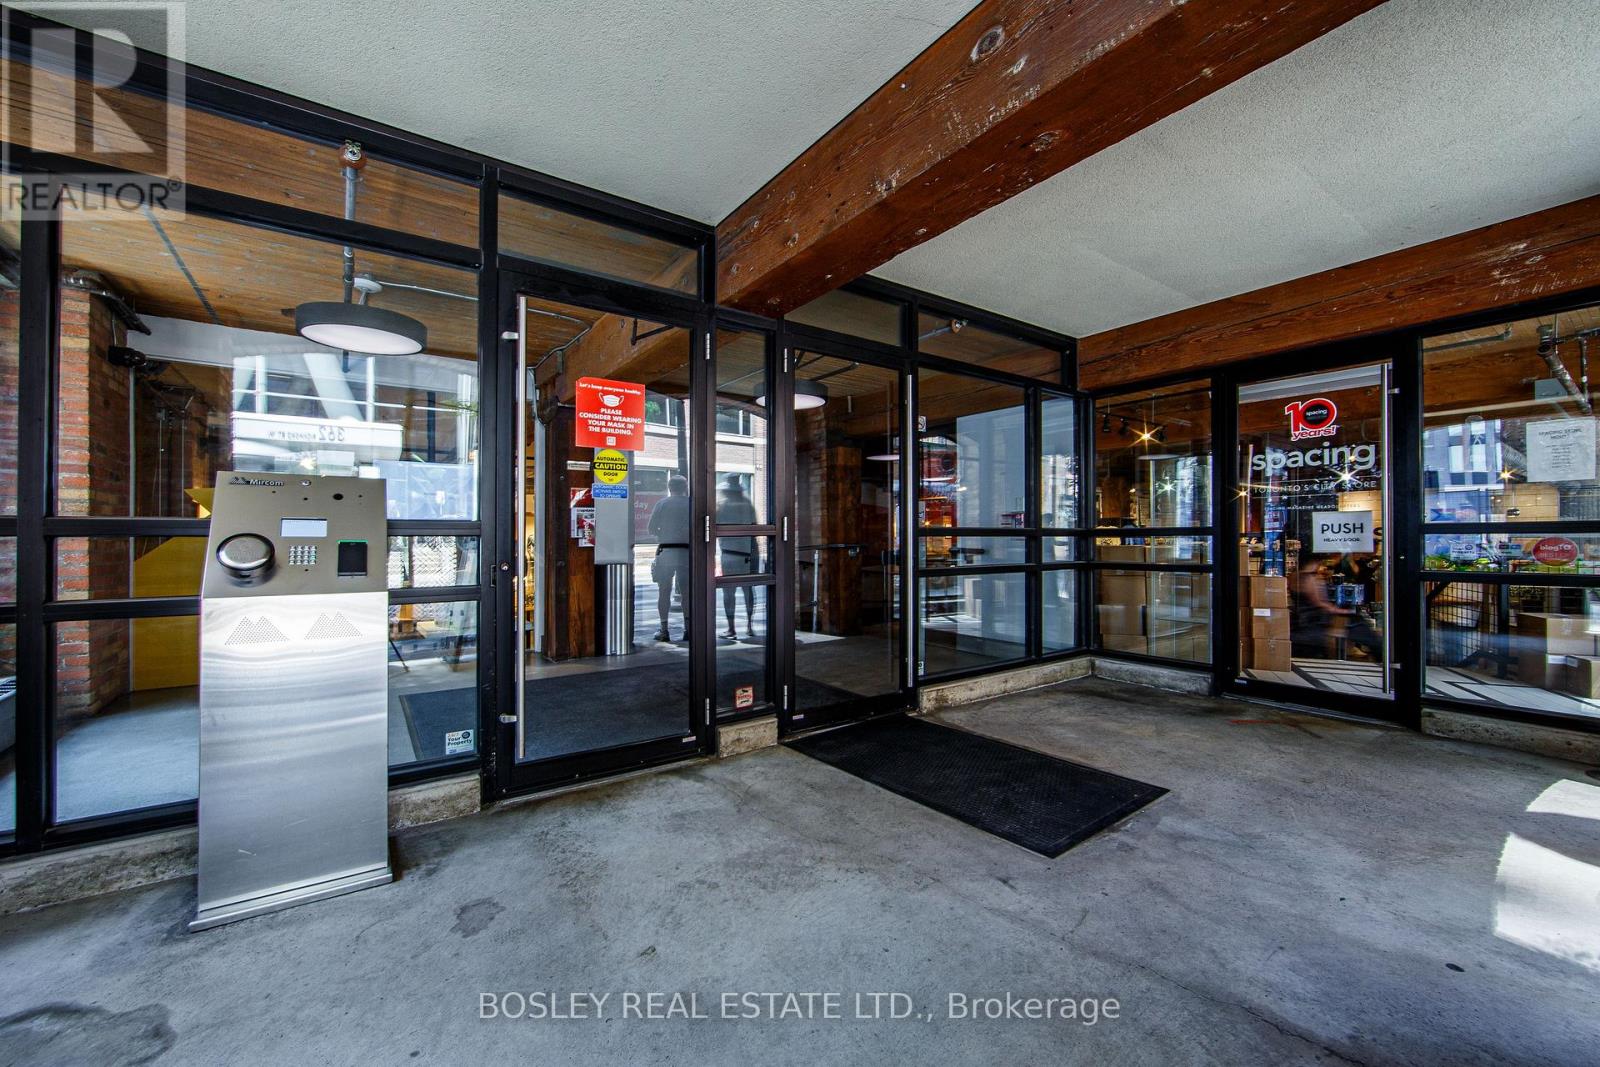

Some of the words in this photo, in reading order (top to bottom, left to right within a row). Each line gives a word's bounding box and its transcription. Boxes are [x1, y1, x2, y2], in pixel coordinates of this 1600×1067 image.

[579, 412, 611, 421] CONSIDER
[612, 415, 642, 424] WEARING
[1285, 398, 1337, 434] 10
[1305, 408, 1328, 417] spacing
[607, 421, 626, 429] MASK
[601, 427, 633, 436] BUILDING.
[1292, 426, 1336, 441] years!
[1252, 441, 1376, 476] spacing
[249, 478, 285, 487] Mircom
[1253, 483, 1309, 494] TORONTO'S
[1321, 522, 1364, 534] PUSH
